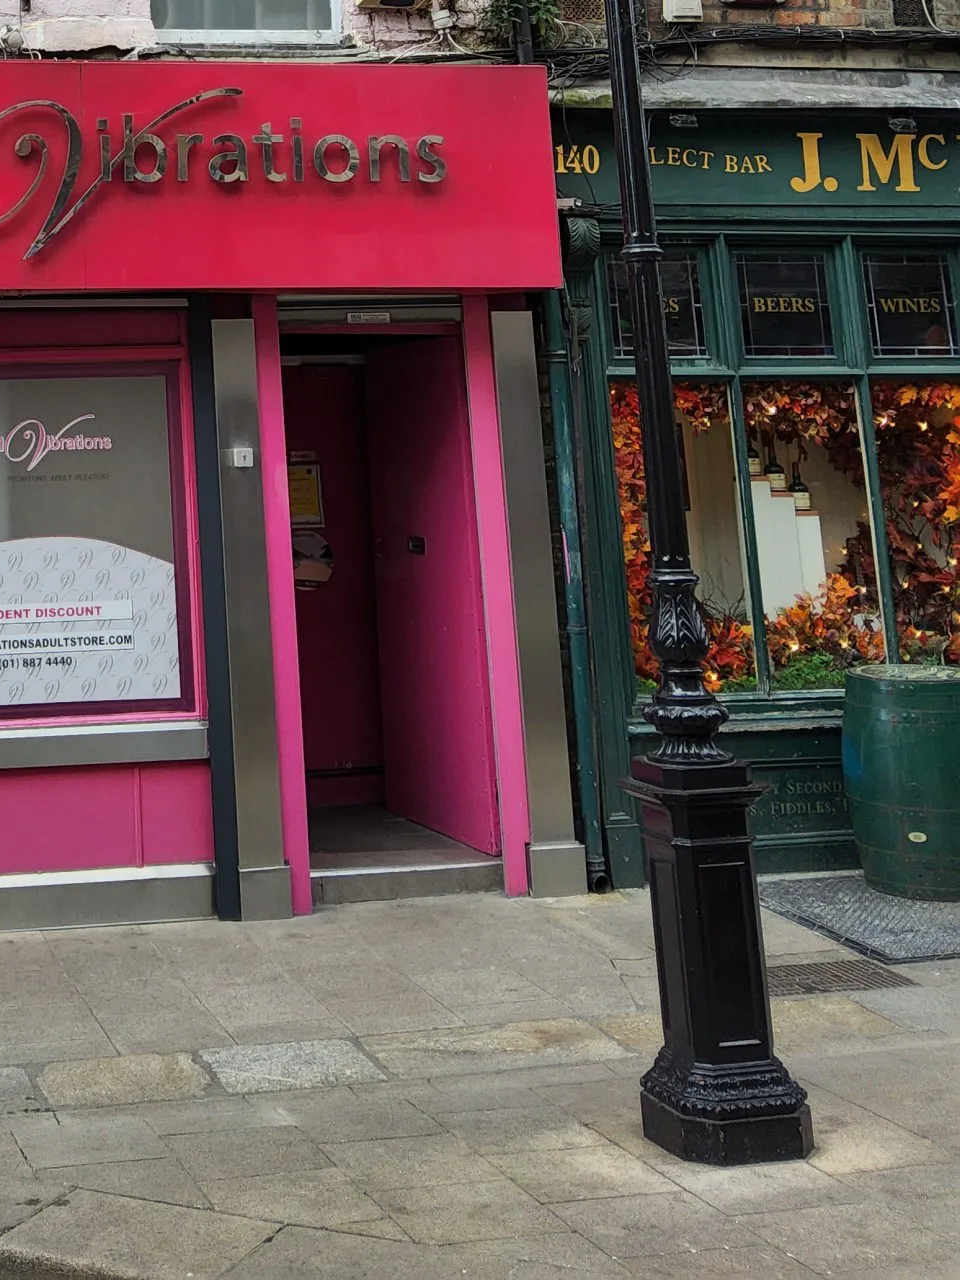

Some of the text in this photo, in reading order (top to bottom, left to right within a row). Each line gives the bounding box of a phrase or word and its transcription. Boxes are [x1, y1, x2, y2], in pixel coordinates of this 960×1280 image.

[555, 144, 600, 174] 140
[649, 146, 772, 174] LECT BAR
[790, 132, 838, 192] J.
[753, 297, 815, 313] BEERS
[880, 298, 940, 313] WINES
[5, 413, 112, 471] Vibrations
[35, 606, 102, 618] DISCOUNT
[22, 657, 41, 668] 887
[45, 656, 72, 667] 4440
